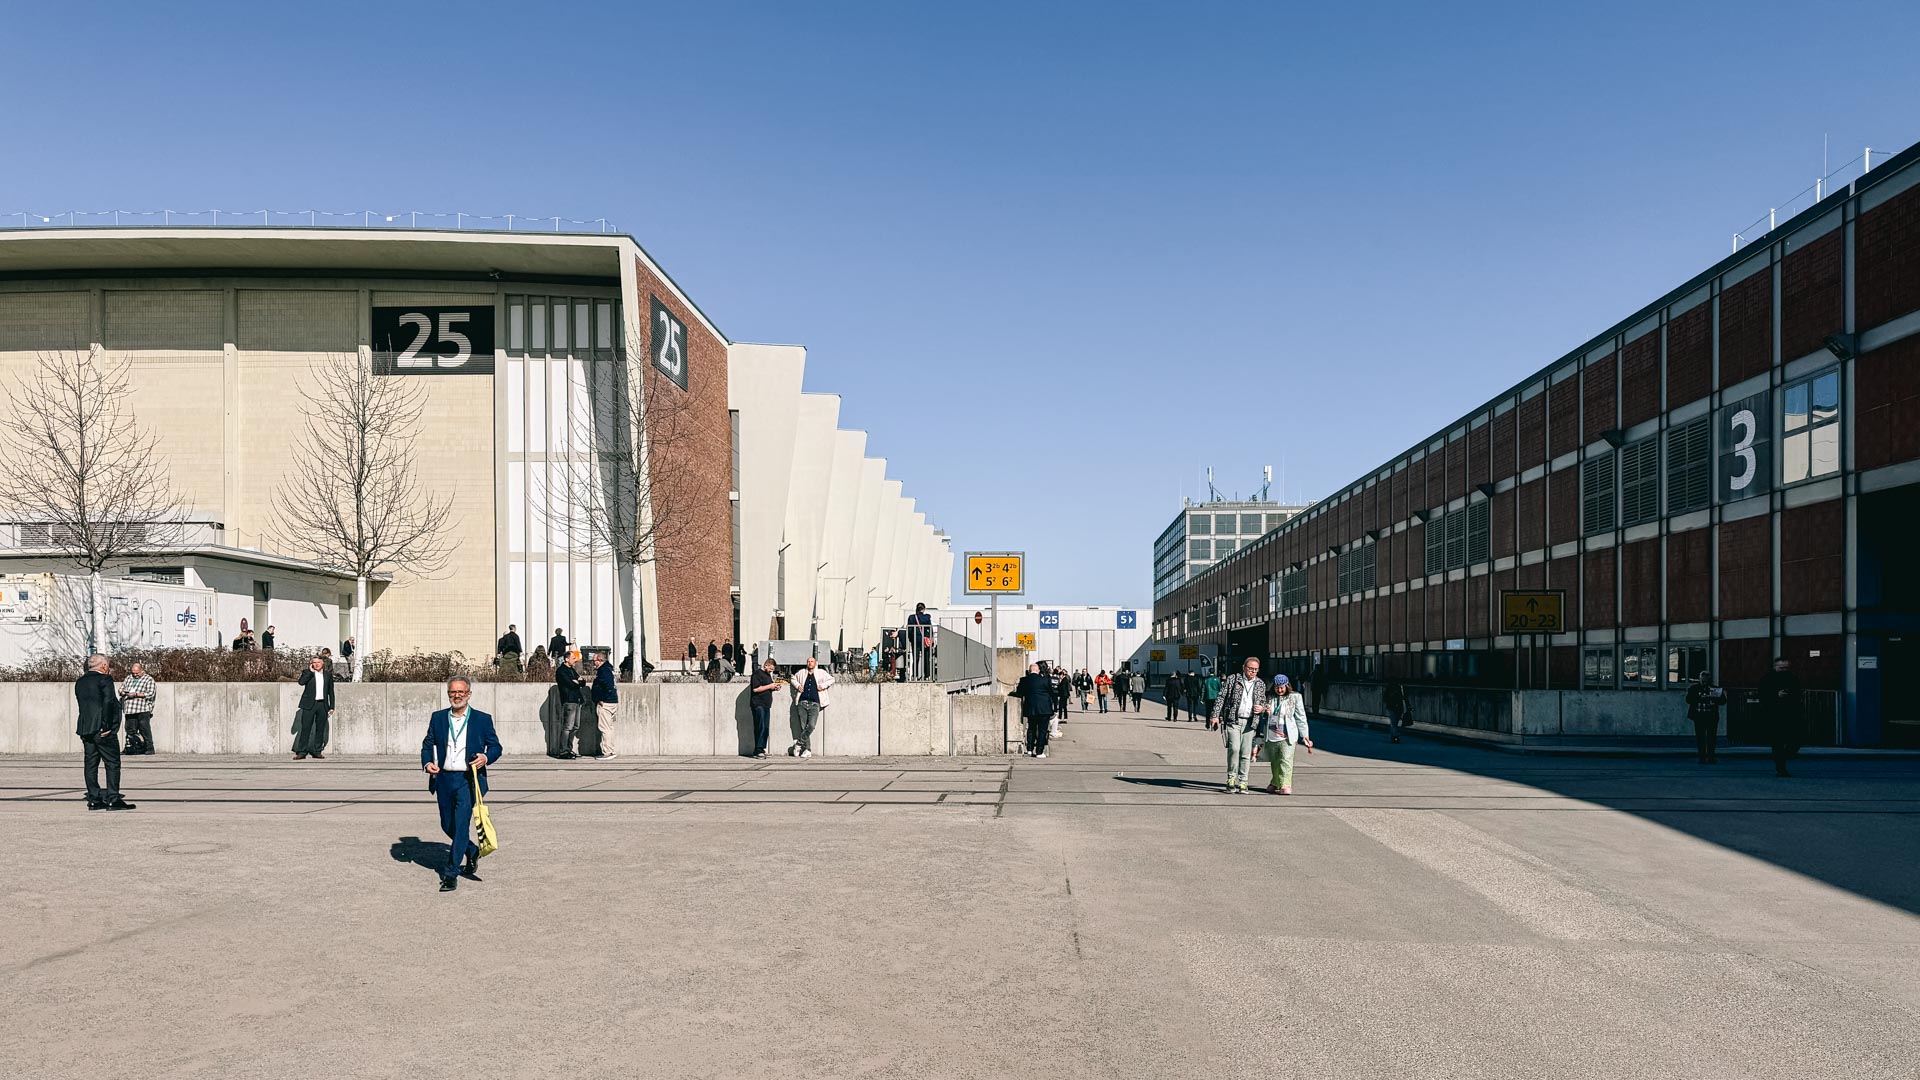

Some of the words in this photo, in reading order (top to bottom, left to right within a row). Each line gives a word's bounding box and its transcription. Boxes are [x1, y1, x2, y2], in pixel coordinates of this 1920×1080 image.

[397, 312, 471, 368] 25
[659, 310, 681, 376] 25
[1730, 409, 1756, 491] 3
[1045, 615, 1058, 625] 25
[1120, 615, 1127, 625] 5
[1510, 614, 1557, 628] 20-23
